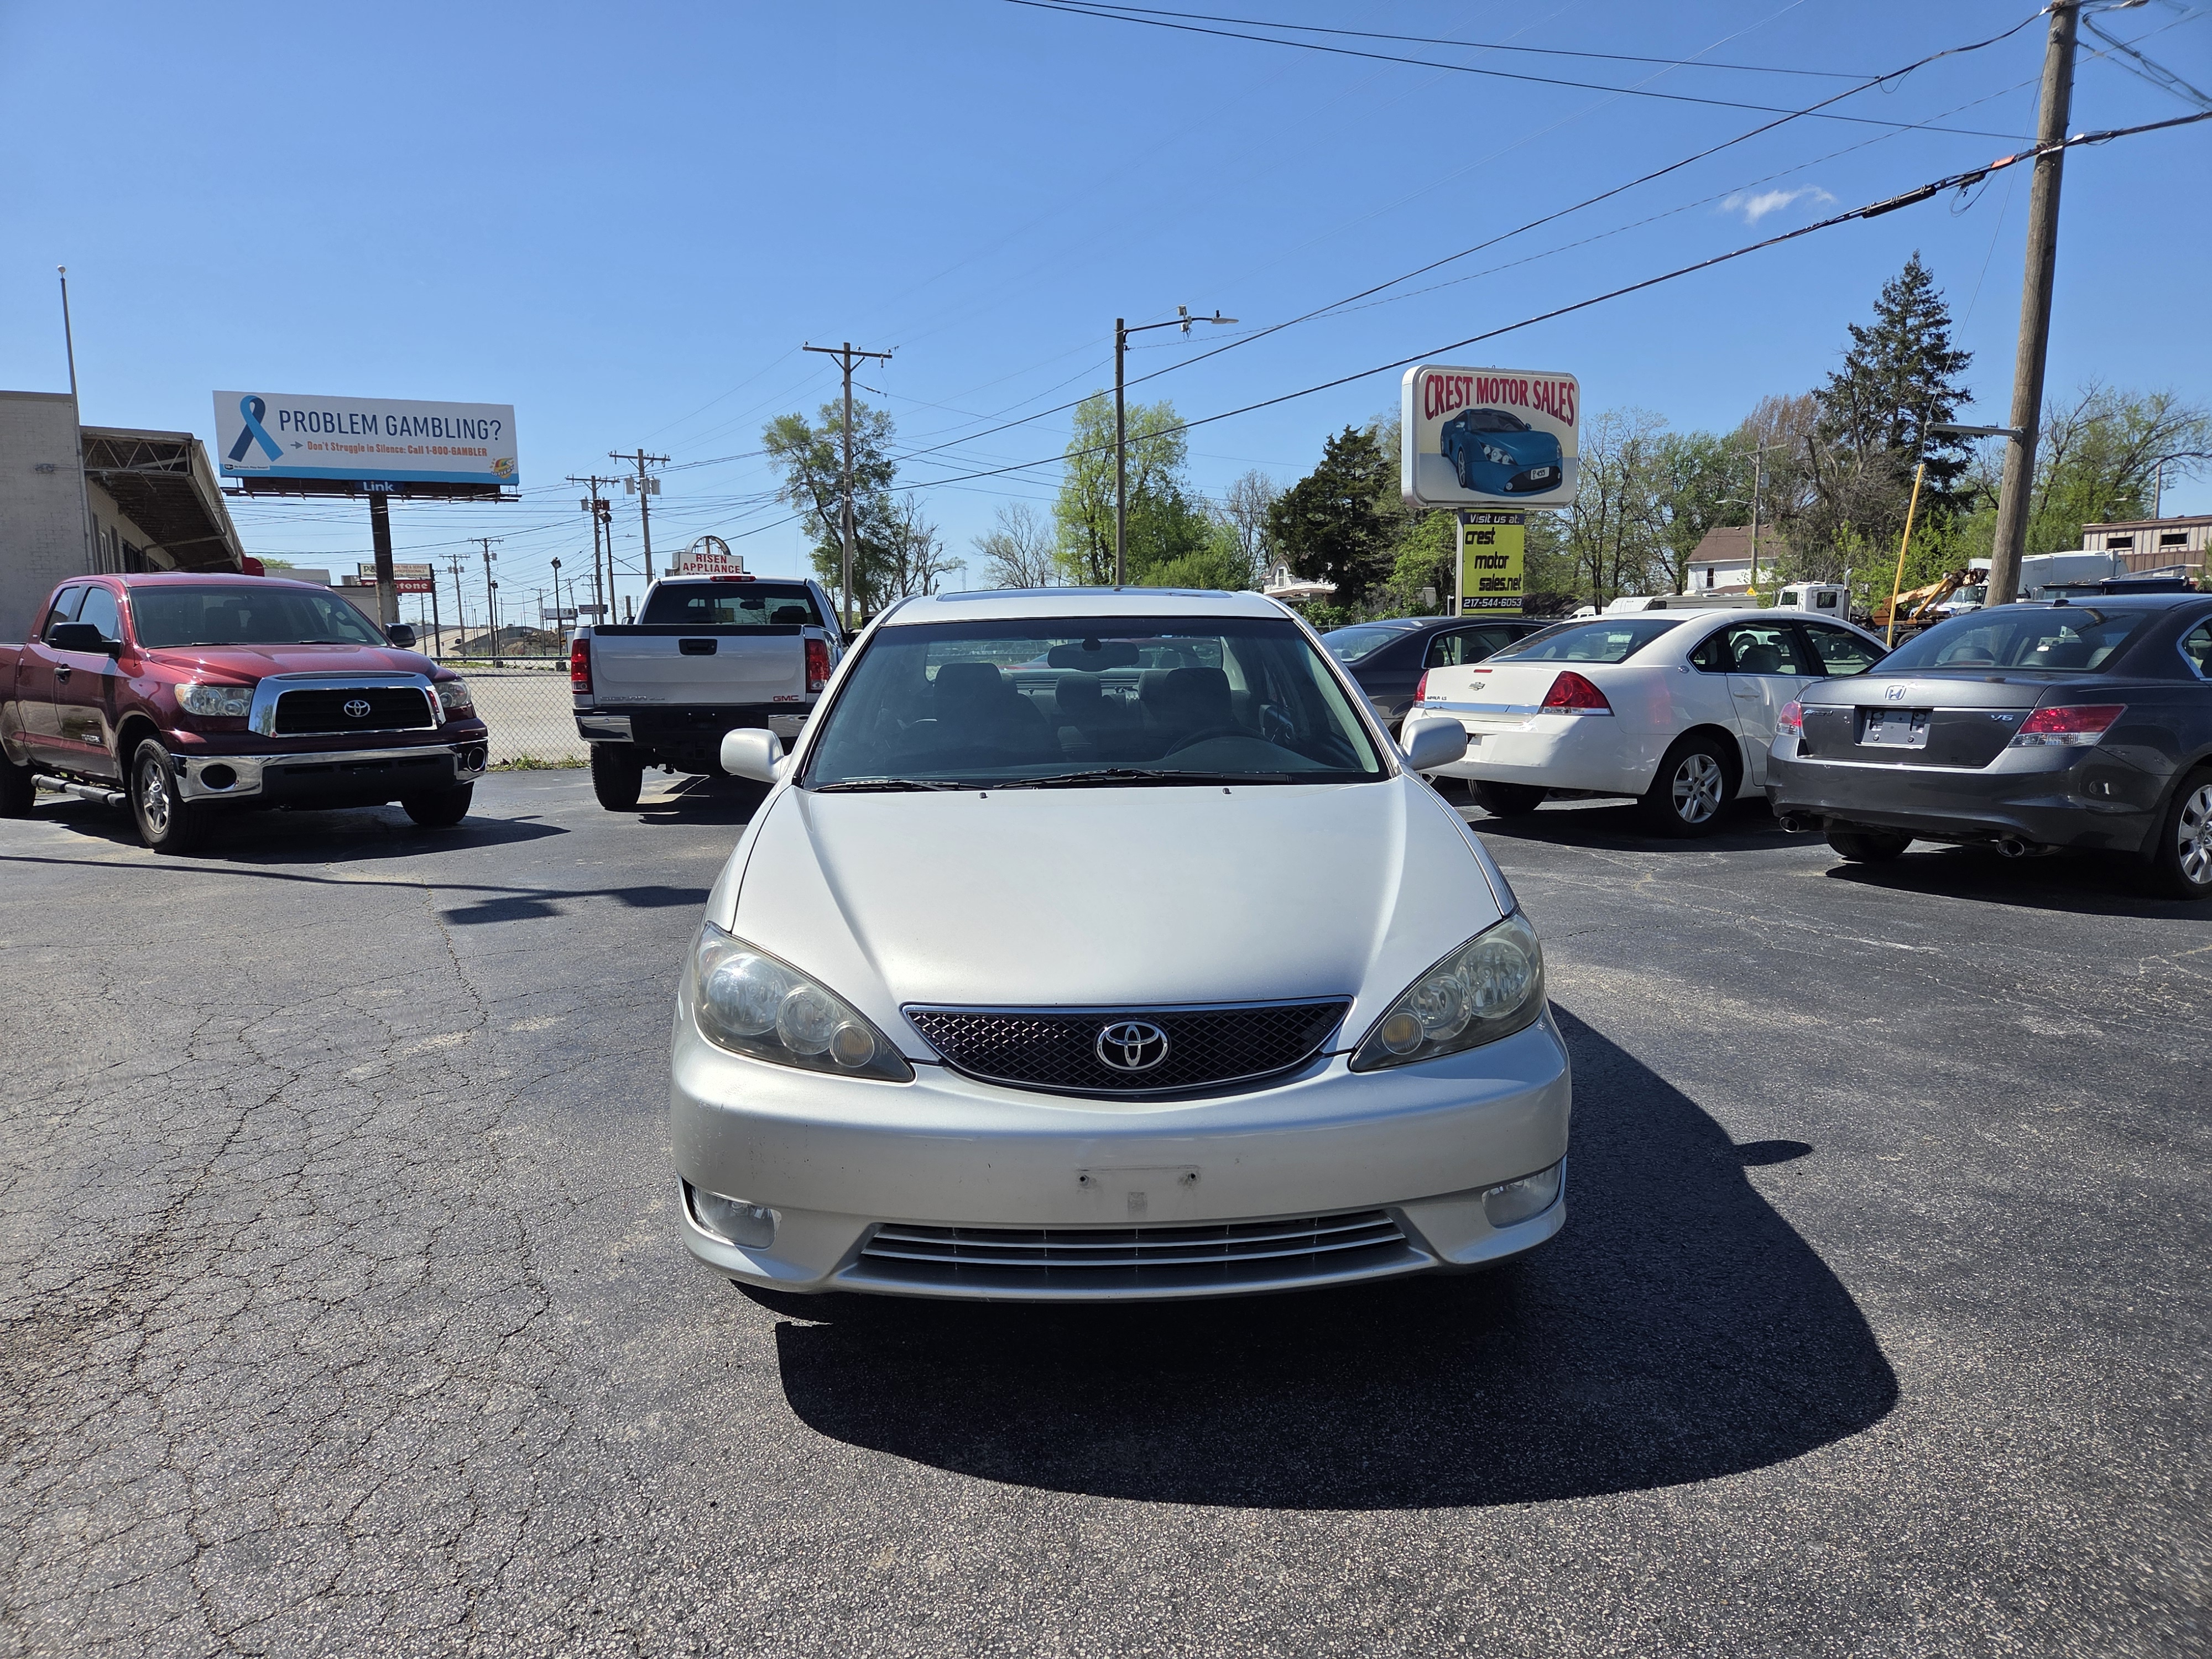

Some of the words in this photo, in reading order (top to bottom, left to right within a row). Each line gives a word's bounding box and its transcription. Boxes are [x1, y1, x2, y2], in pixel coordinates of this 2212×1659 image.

[1425, 374, 1473, 420] CREST
[1477, 377, 1529, 407] MOTOR
[1533, 380, 1574, 427] SALES
[279, 410, 378, 435] PROBLEM
[385, 415, 501, 441] GAMBLING?
[307, 441, 329, 451] Don't
[331, 442, 365, 454] Struggle
[367, 444, 374, 452] in
[376, 444, 406, 453] Silence:
[408, 445, 424, 454] Call
[425, 446, 487, 456] 1-800-GAMBLER
[363, 481, 395, 492] Link
[1470, 514, 1491, 523] Visit
[1509, 514, 1520, 524] at:
[1465, 526, 1495, 545] crest
[696, 554, 727, 564] RISEN
[1474, 551, 1509, 569] motor
[682, 562, 740, 574] APPLIANCE
[1479, 573, 1522, 591] sales.net
[1463, 598, 1522, 607] 217-544-6053
